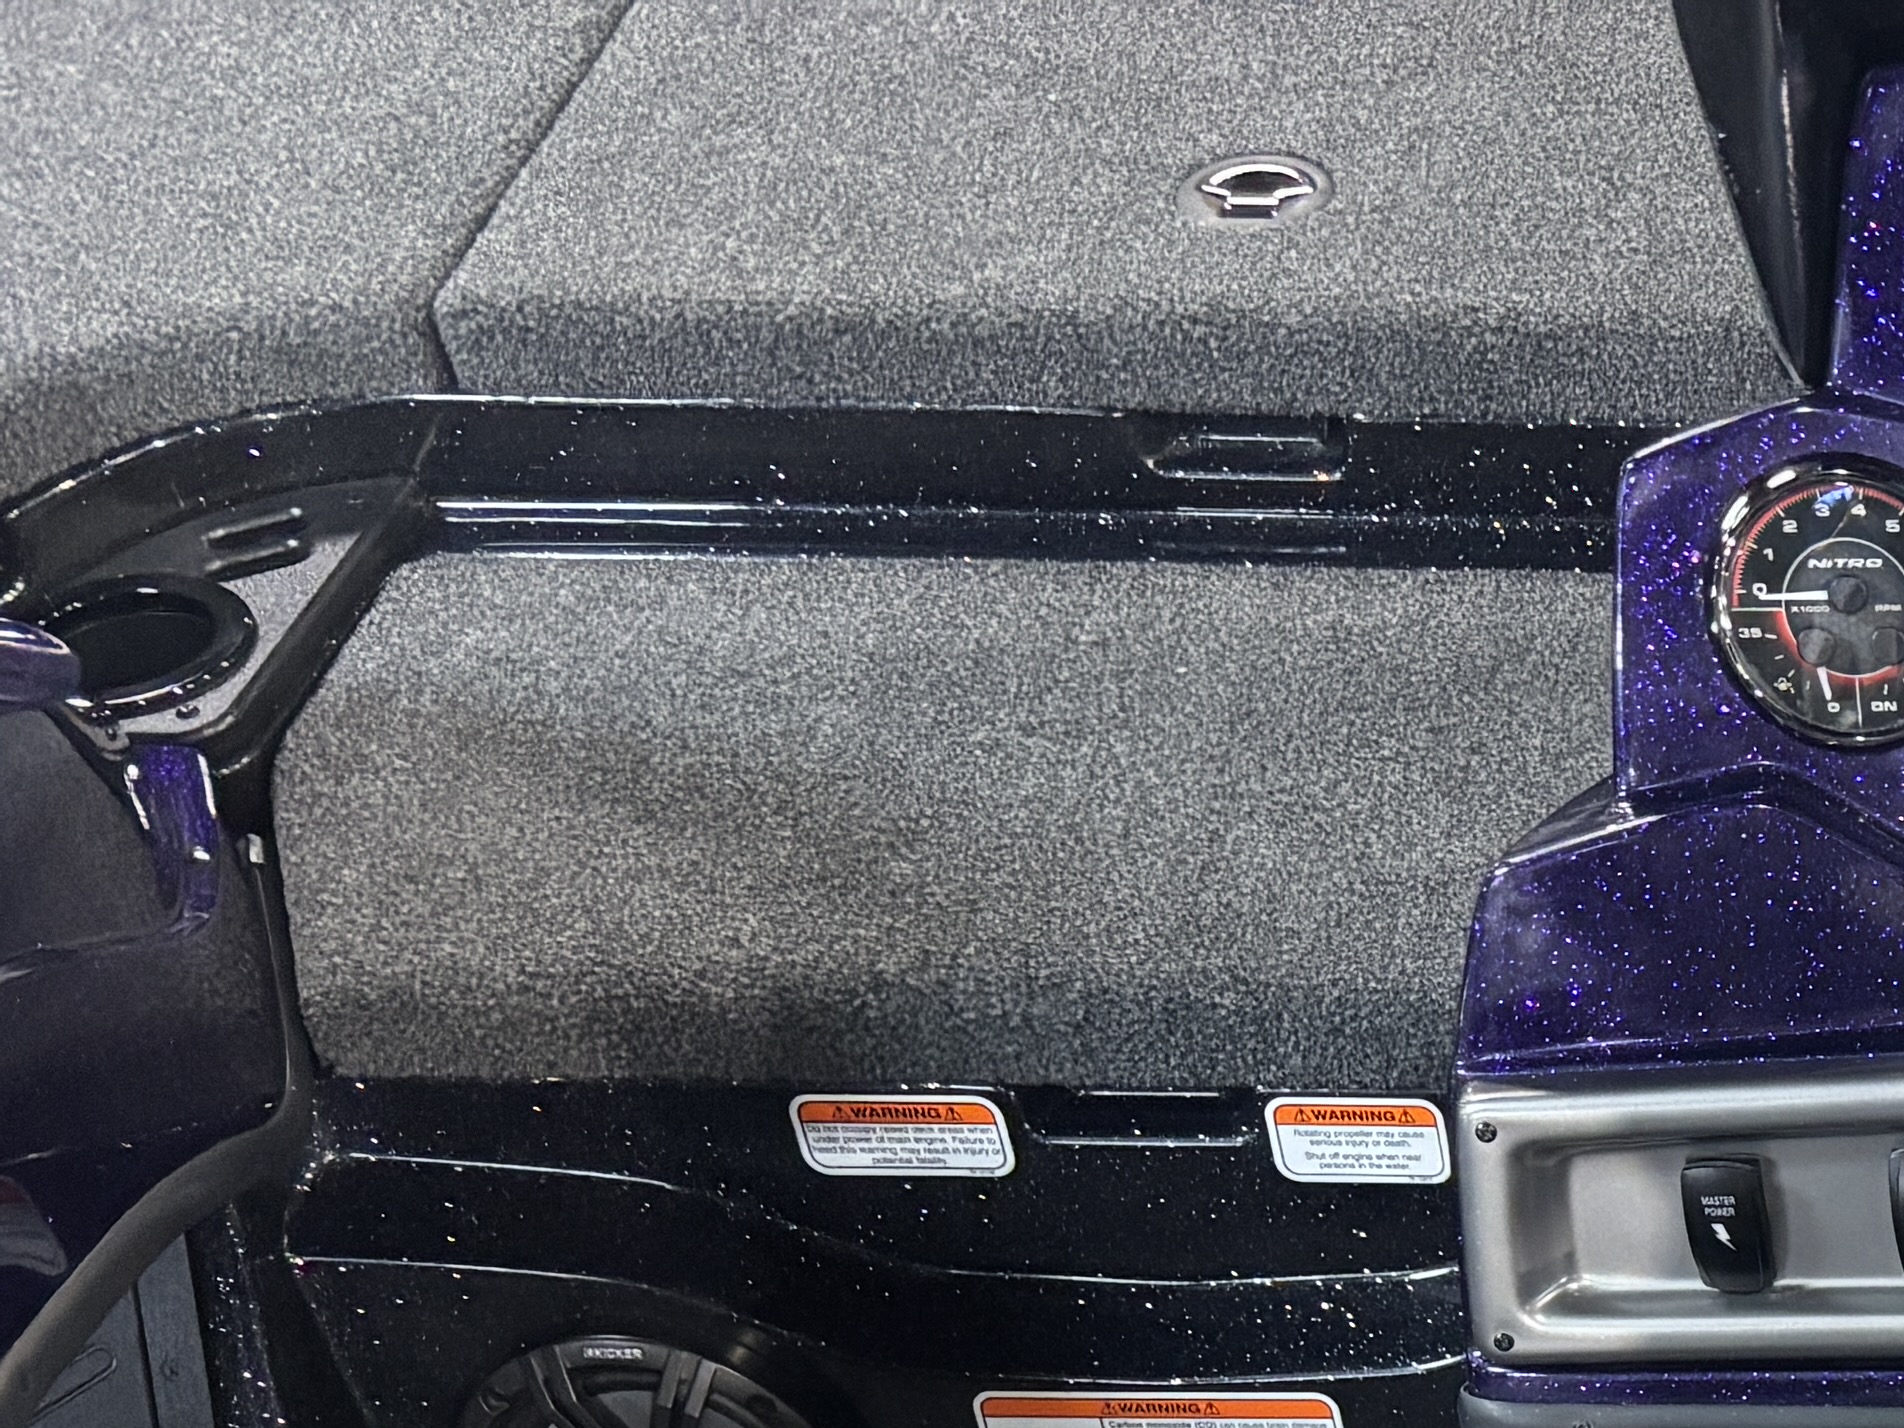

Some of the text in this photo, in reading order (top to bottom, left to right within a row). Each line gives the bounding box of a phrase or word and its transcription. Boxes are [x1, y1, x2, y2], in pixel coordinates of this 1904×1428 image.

[1815, 502, 1830, 517] 3
[1850, 503, 1867, 517] 4
[1782, 519, 1798, 534] 2
[1885, 519, 1901, 534] 5
[1763, 548, 1774, 561] 1
[1807, 558, 1884, 569] NITRO
[1752, 583, 1767, 597] 0
[849, 1106, 942, 1119] WARNING
[1311, 1109, 1396, 1122] WARNING
[1700, 1195, 1736, 1206] MASTER
[1118, 1403, 1201, 1414] WARNING
